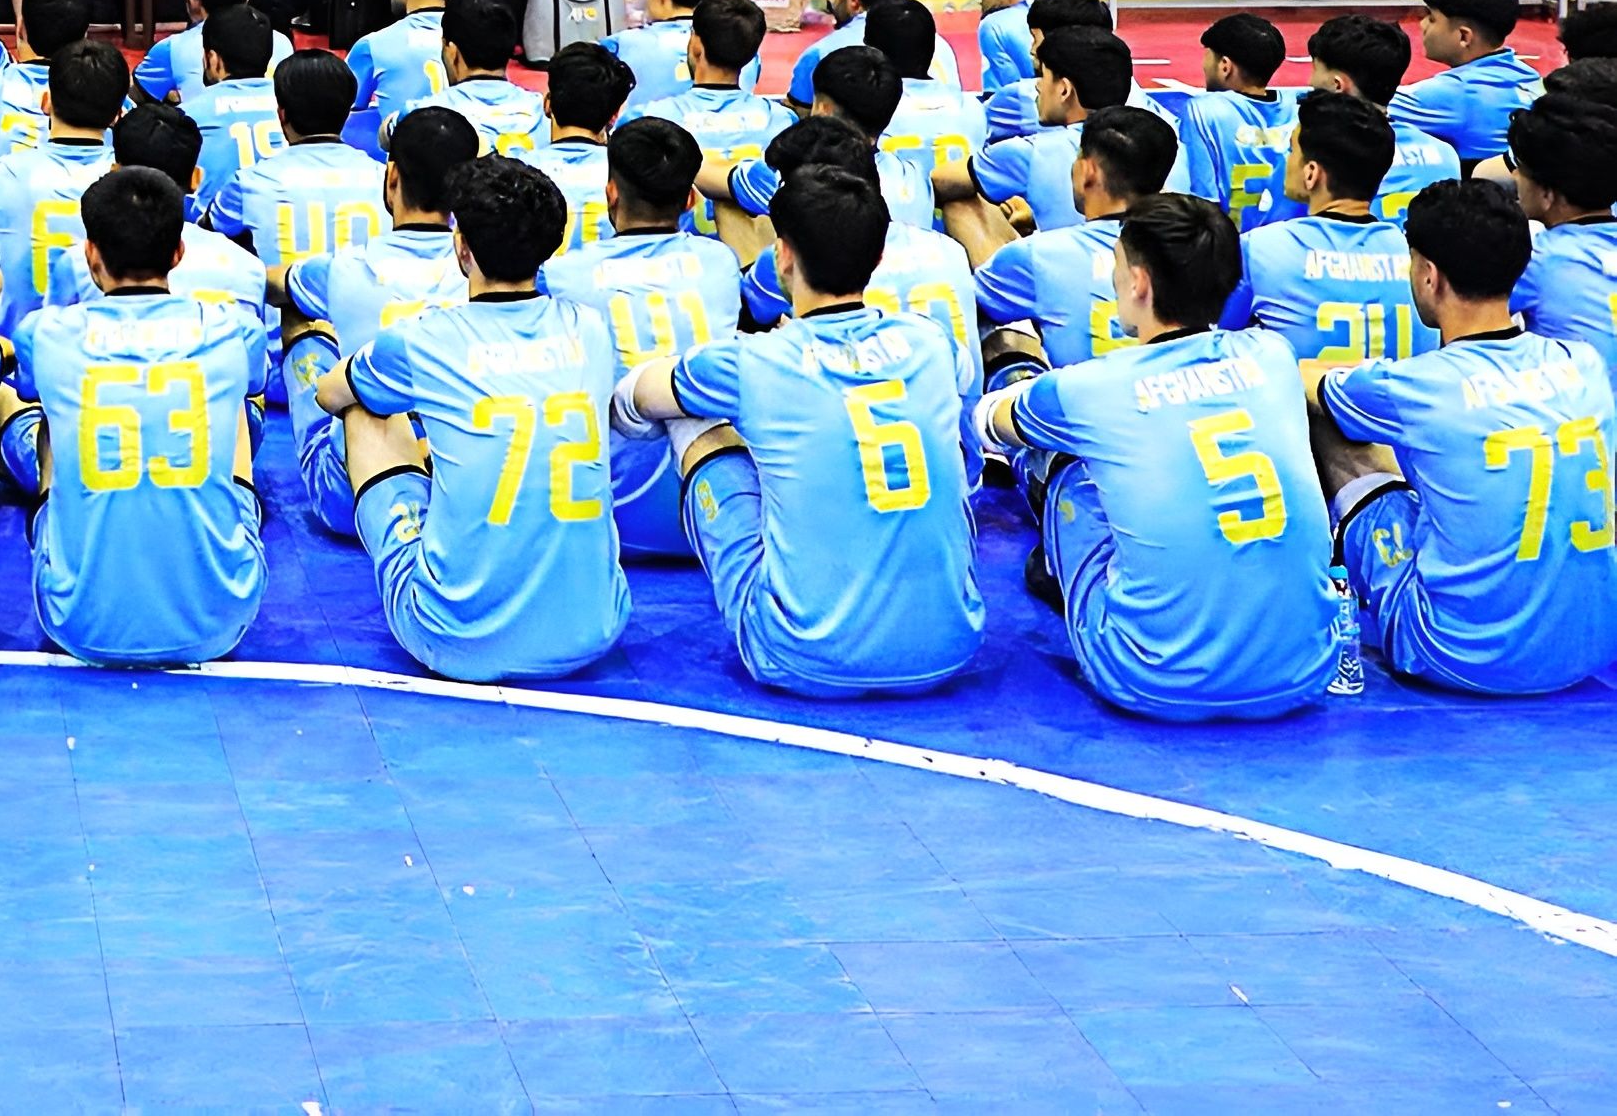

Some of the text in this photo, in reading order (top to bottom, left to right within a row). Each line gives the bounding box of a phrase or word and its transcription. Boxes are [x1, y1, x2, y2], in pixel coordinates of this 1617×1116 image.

[78, 361, 211, 493] 63
[472, 390, 603, 526] 72
[843, 378, 931, 515] 6
[1188, 408, 1288, 545] 5
[1483, 415, 1617, 563] 73
